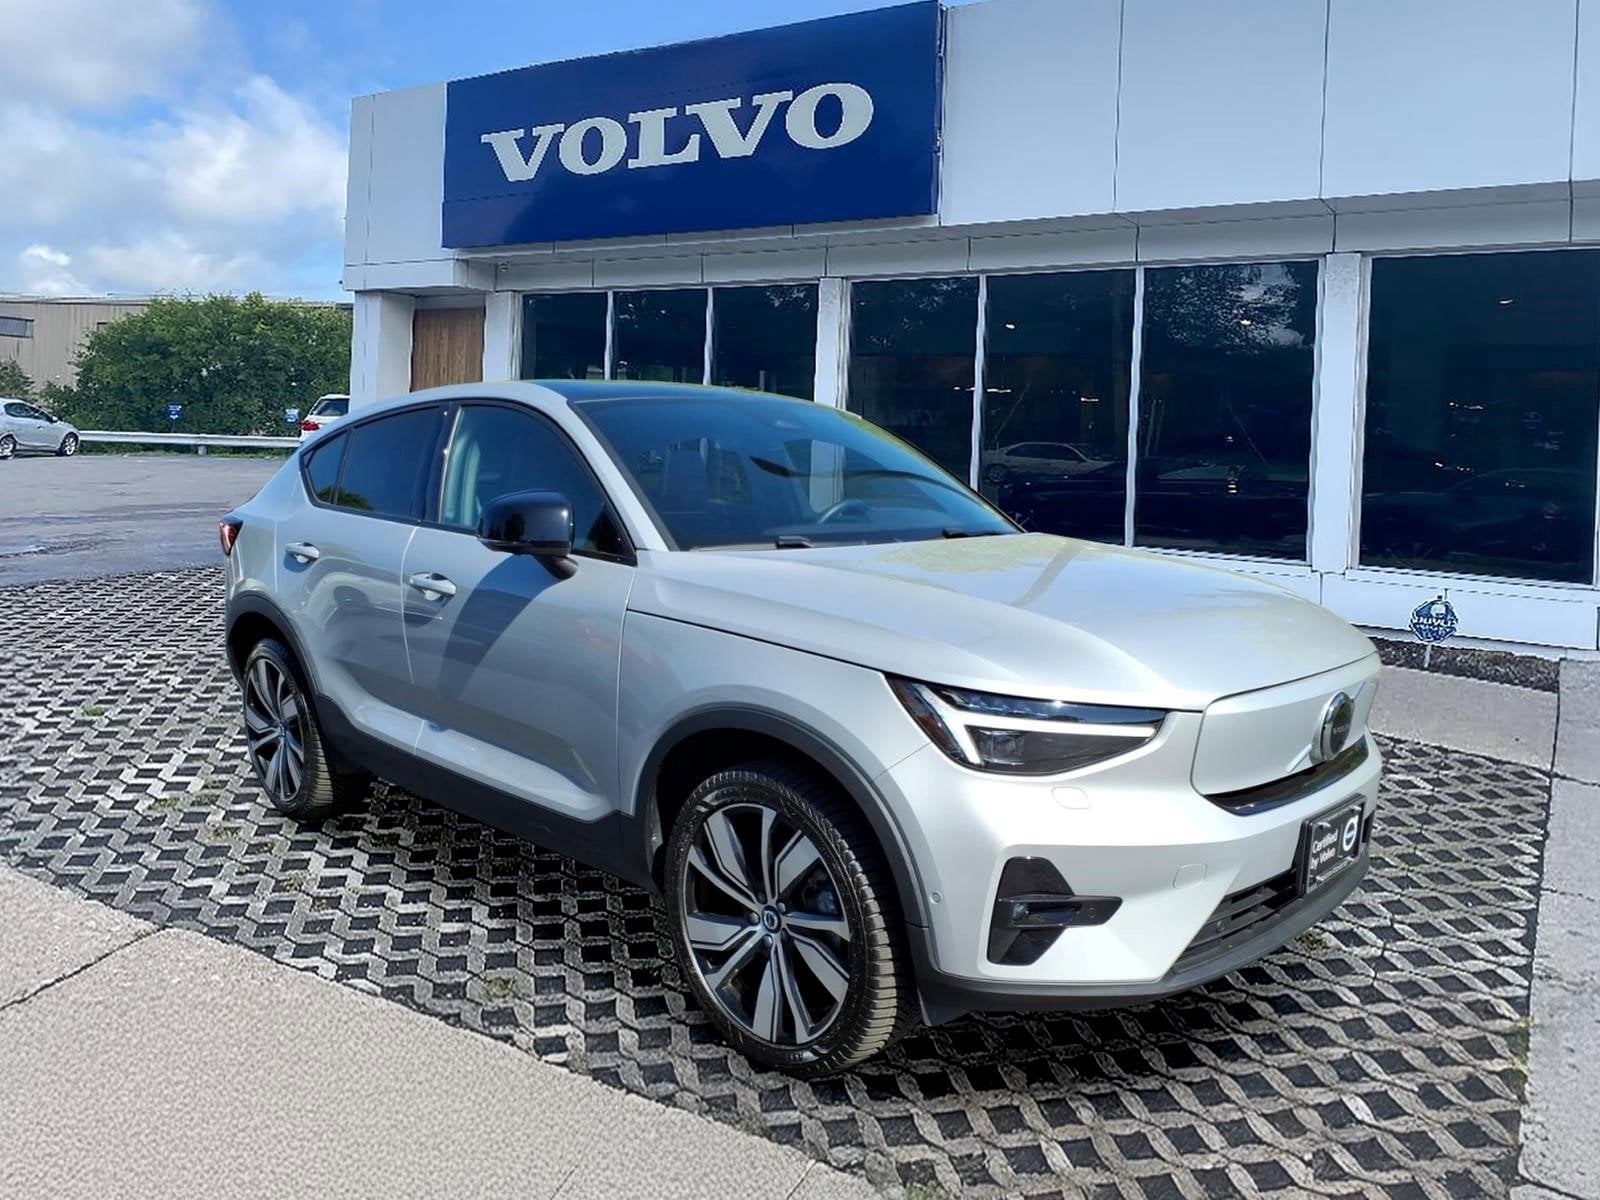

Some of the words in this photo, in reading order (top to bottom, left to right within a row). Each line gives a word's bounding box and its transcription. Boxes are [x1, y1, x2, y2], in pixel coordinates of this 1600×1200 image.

[481, 82, 874, 182] VOLVO
[1312, 829, 1338, 853] Certified
[1310, 857, 1319, 870] by
[1320, 848, 1336, 863] Volvo
